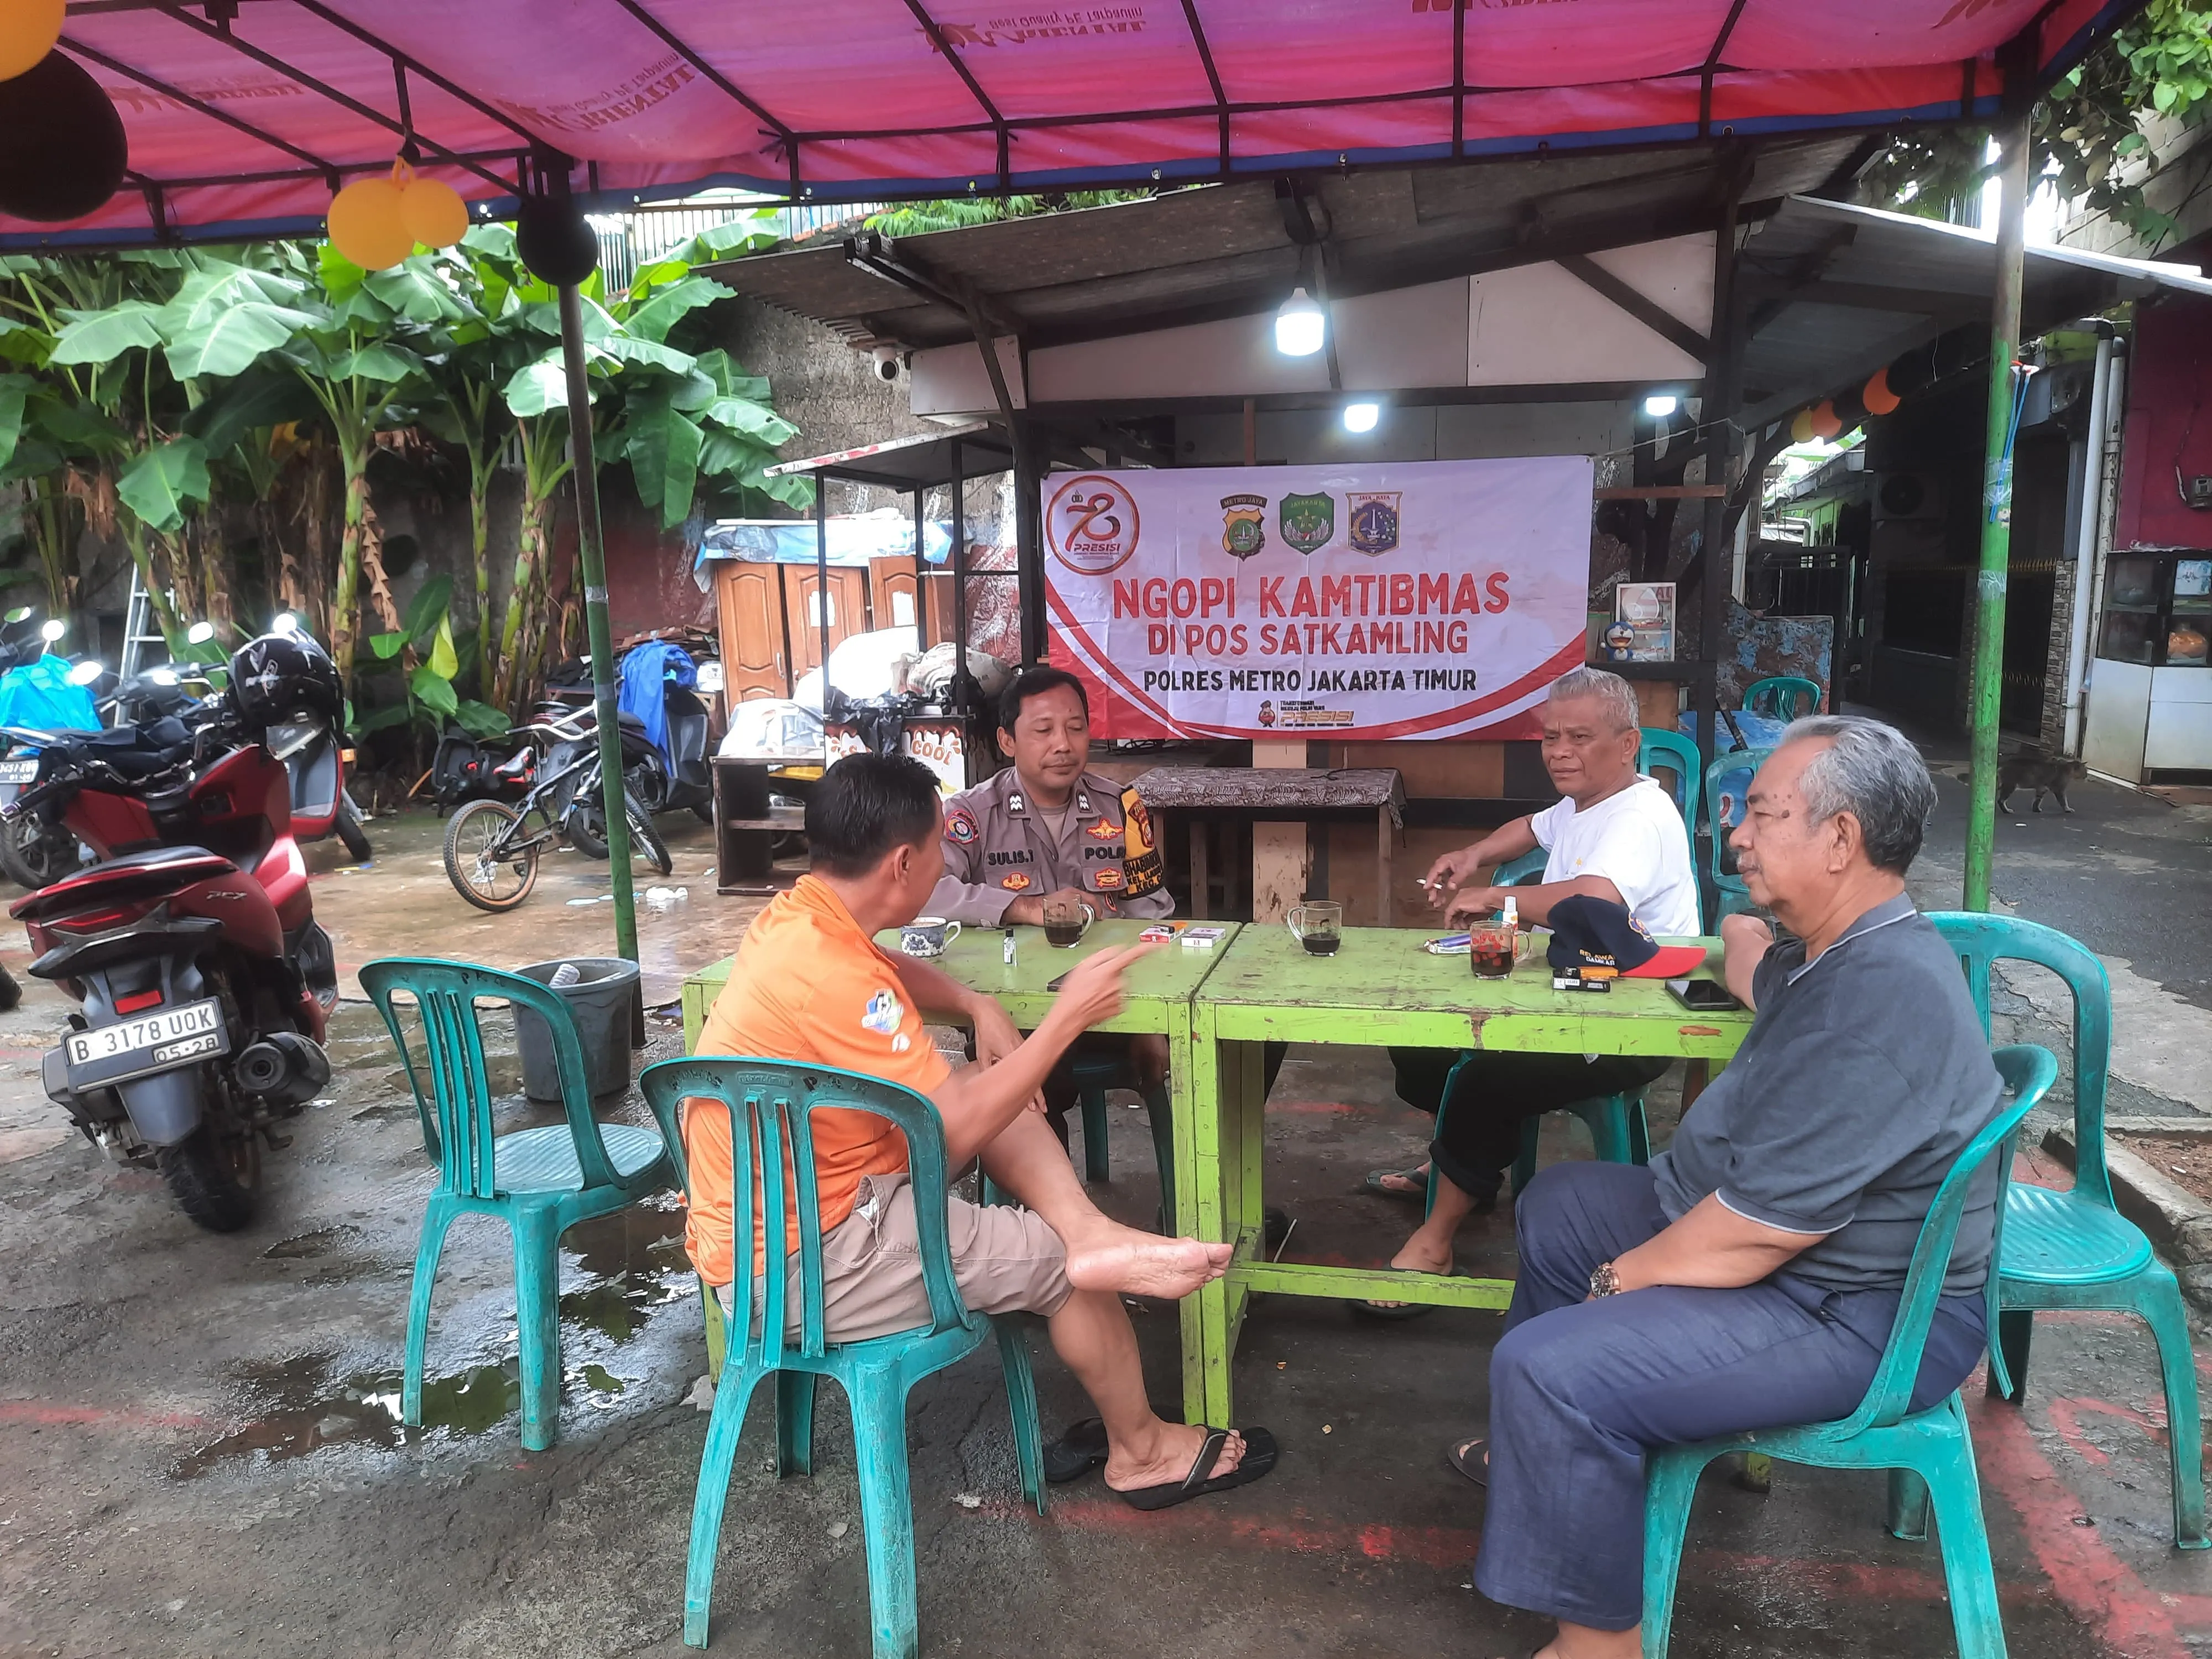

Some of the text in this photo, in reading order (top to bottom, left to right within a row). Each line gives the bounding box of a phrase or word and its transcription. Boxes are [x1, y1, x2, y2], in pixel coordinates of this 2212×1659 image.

[1073, 543, 1121, 552] PRESISI
[1114, 572, 1510, 618] NGOPI KAMTIBMAS
[1148, 621, 1468, 655] DI POS SATKAMLING
[1144, 669, 1476, 691] POLRES METRO JAKARTA TIMUR
[1280, 711, 1354, 722] PRESISI
[911, 740, 952, 766] COOL
[1084, 846, 1126, 859] POLR
[1579, 948, 1616, 961] RELAWA
[75, 1040, 90, 1061] B
[104, 1021, 161, 1052] 3178
